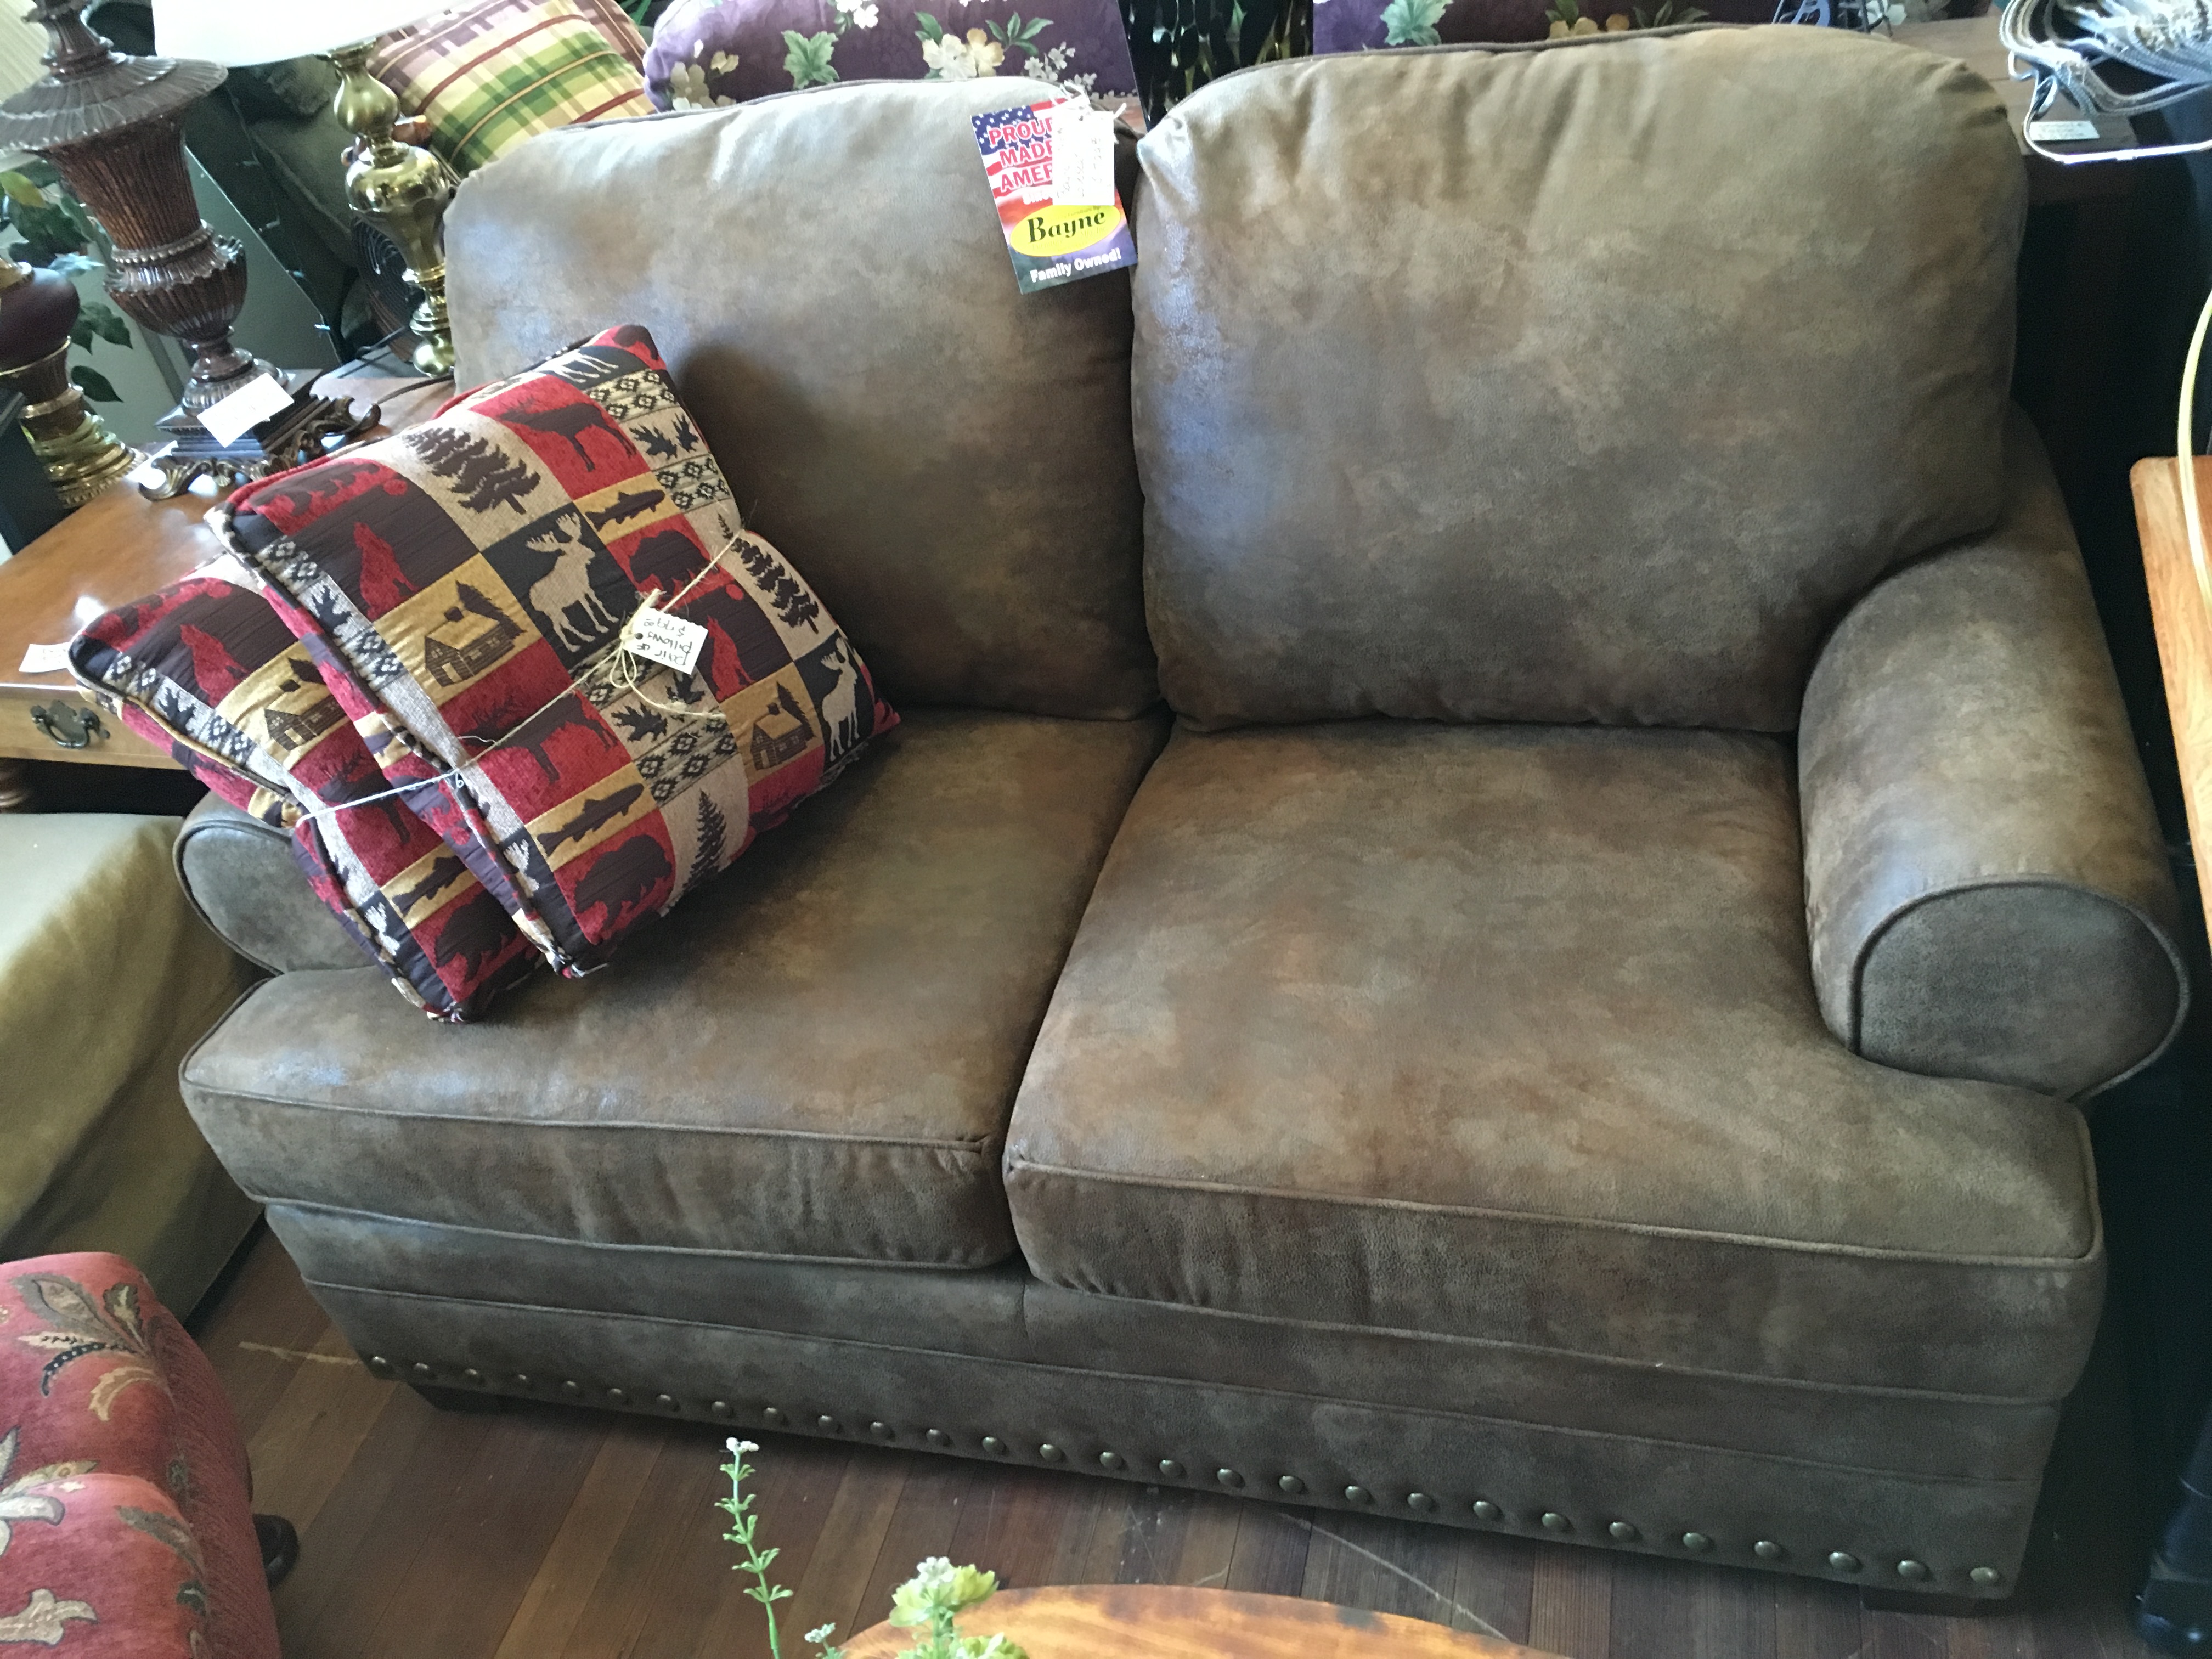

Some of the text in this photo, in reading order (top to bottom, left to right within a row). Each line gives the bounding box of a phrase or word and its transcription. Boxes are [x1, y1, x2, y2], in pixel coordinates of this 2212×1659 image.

[1001, 163, 1052, 191] AMER
[1027, 211, 1106, 243] Bayne
[1029, 247, 1122, 283] Family Owned!
[647, 631, 693, 654] pillows
